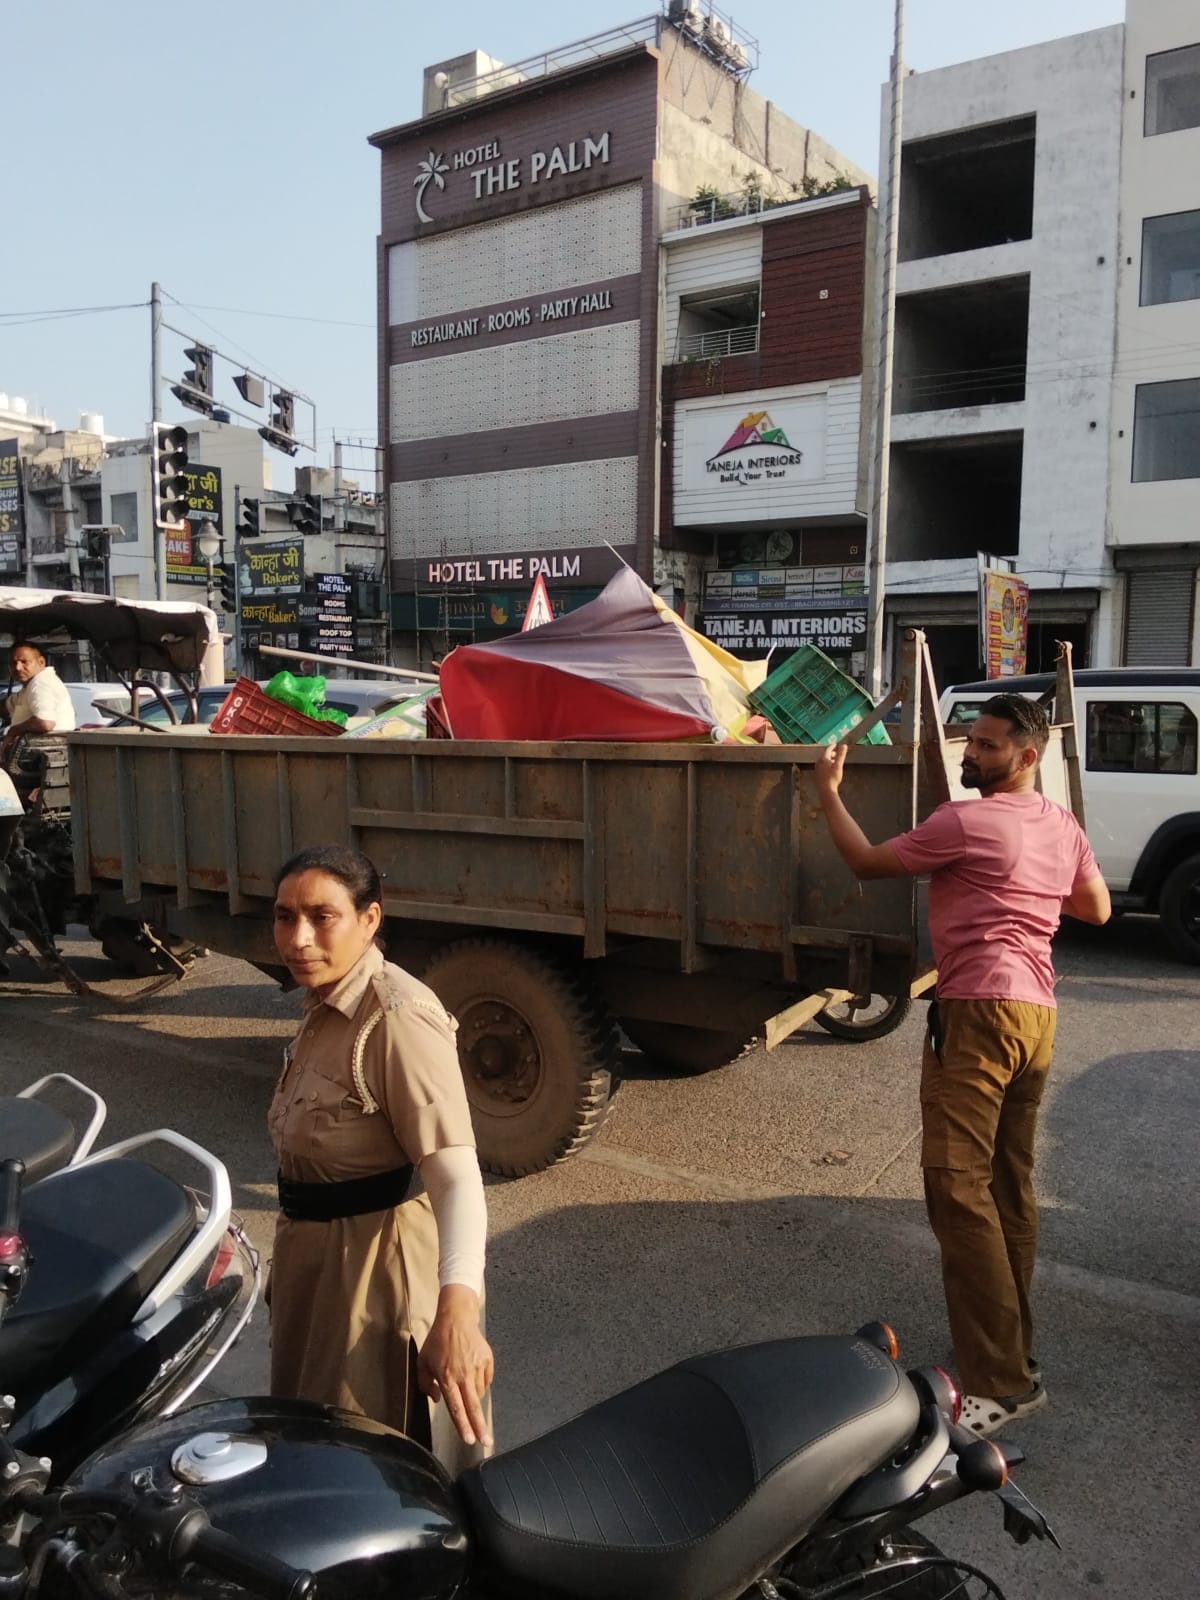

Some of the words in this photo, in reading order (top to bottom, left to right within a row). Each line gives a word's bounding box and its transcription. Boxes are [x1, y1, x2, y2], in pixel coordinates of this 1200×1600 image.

[454, 142, 500, 171] HOTEL
[470, 159, 521, 199] THE
[531, 132, 610, 183] PALM
[411, 318, 479, 347] RESTAURANT
[488, 307, 530, 332] ROOMS
[540, 298, 578, 322] PARTY
[580, 290, 611, 313] HALL
[706, 460, 744, 472] TANEJA
[748, 454, 801, 469] INTERIORS
[720, 472, 740, 483] Build
[744, 472, 762, 481] Your
[766, 470, 786, 479] Trust
[167, 540, 190, 553] AKE
[250, 552, 281, 573] कान्हा
[283, 546, 299, 568] जी
[428, 561, 486, 583] HOTEL
[487, 558, 524, 580] THE
[529, 555, 581, 579] PALM
[323, 576, 345, 584] HOTEL
[318, 583, 332, 592] THE
[333, 584, 352, 593] PALM
[324, 600, 346, 608] ROOMS
[318, 614, 353, 622] RESTAURANT
[319, 629, 338, 637] ROOF
[704, 619, 766, 636] TANEJA
[771, 617, 866, 635] INTERIORS
[319, 643, 339, 651] PARTY
[339, 644, 354, 652] HALL
[716, 638, 745, 648] PAINT
[745, 638, 755, 648] &
[757, 637, 813, 648] HARDWARE
[817, 637, 852, 648] STORE
